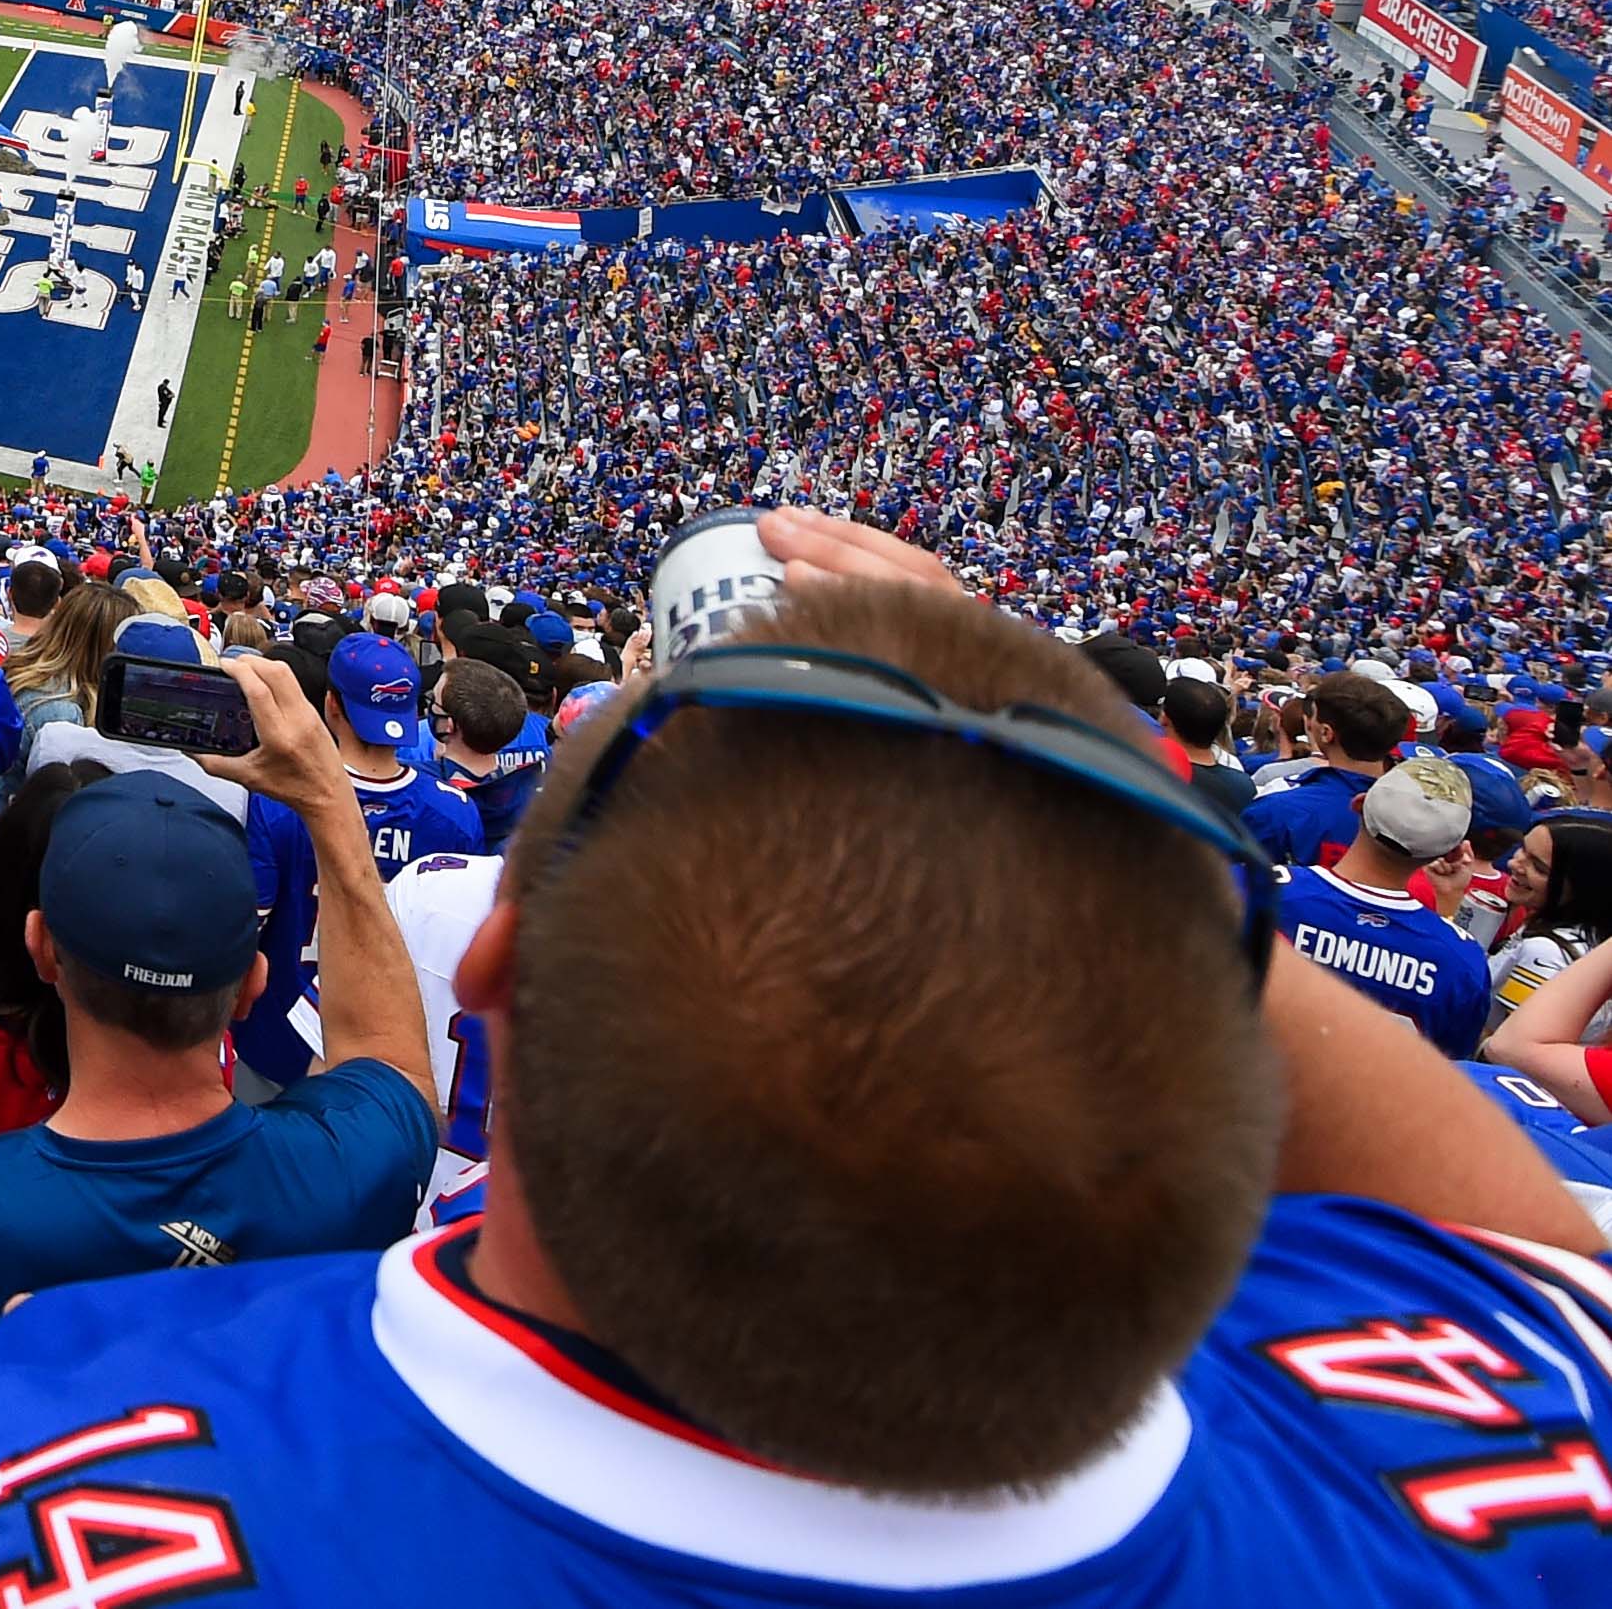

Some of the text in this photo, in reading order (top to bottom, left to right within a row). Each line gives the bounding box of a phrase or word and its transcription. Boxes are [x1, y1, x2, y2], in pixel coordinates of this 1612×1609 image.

[1500, 76, 1571, 138] northtown
[184, 183, 215, 212] END
[123, 963, 193, 988] FREEDOM
[1294, 922, 1438, 997] EDMUNDS
[1266, 1318, 1612, 1550] 14
